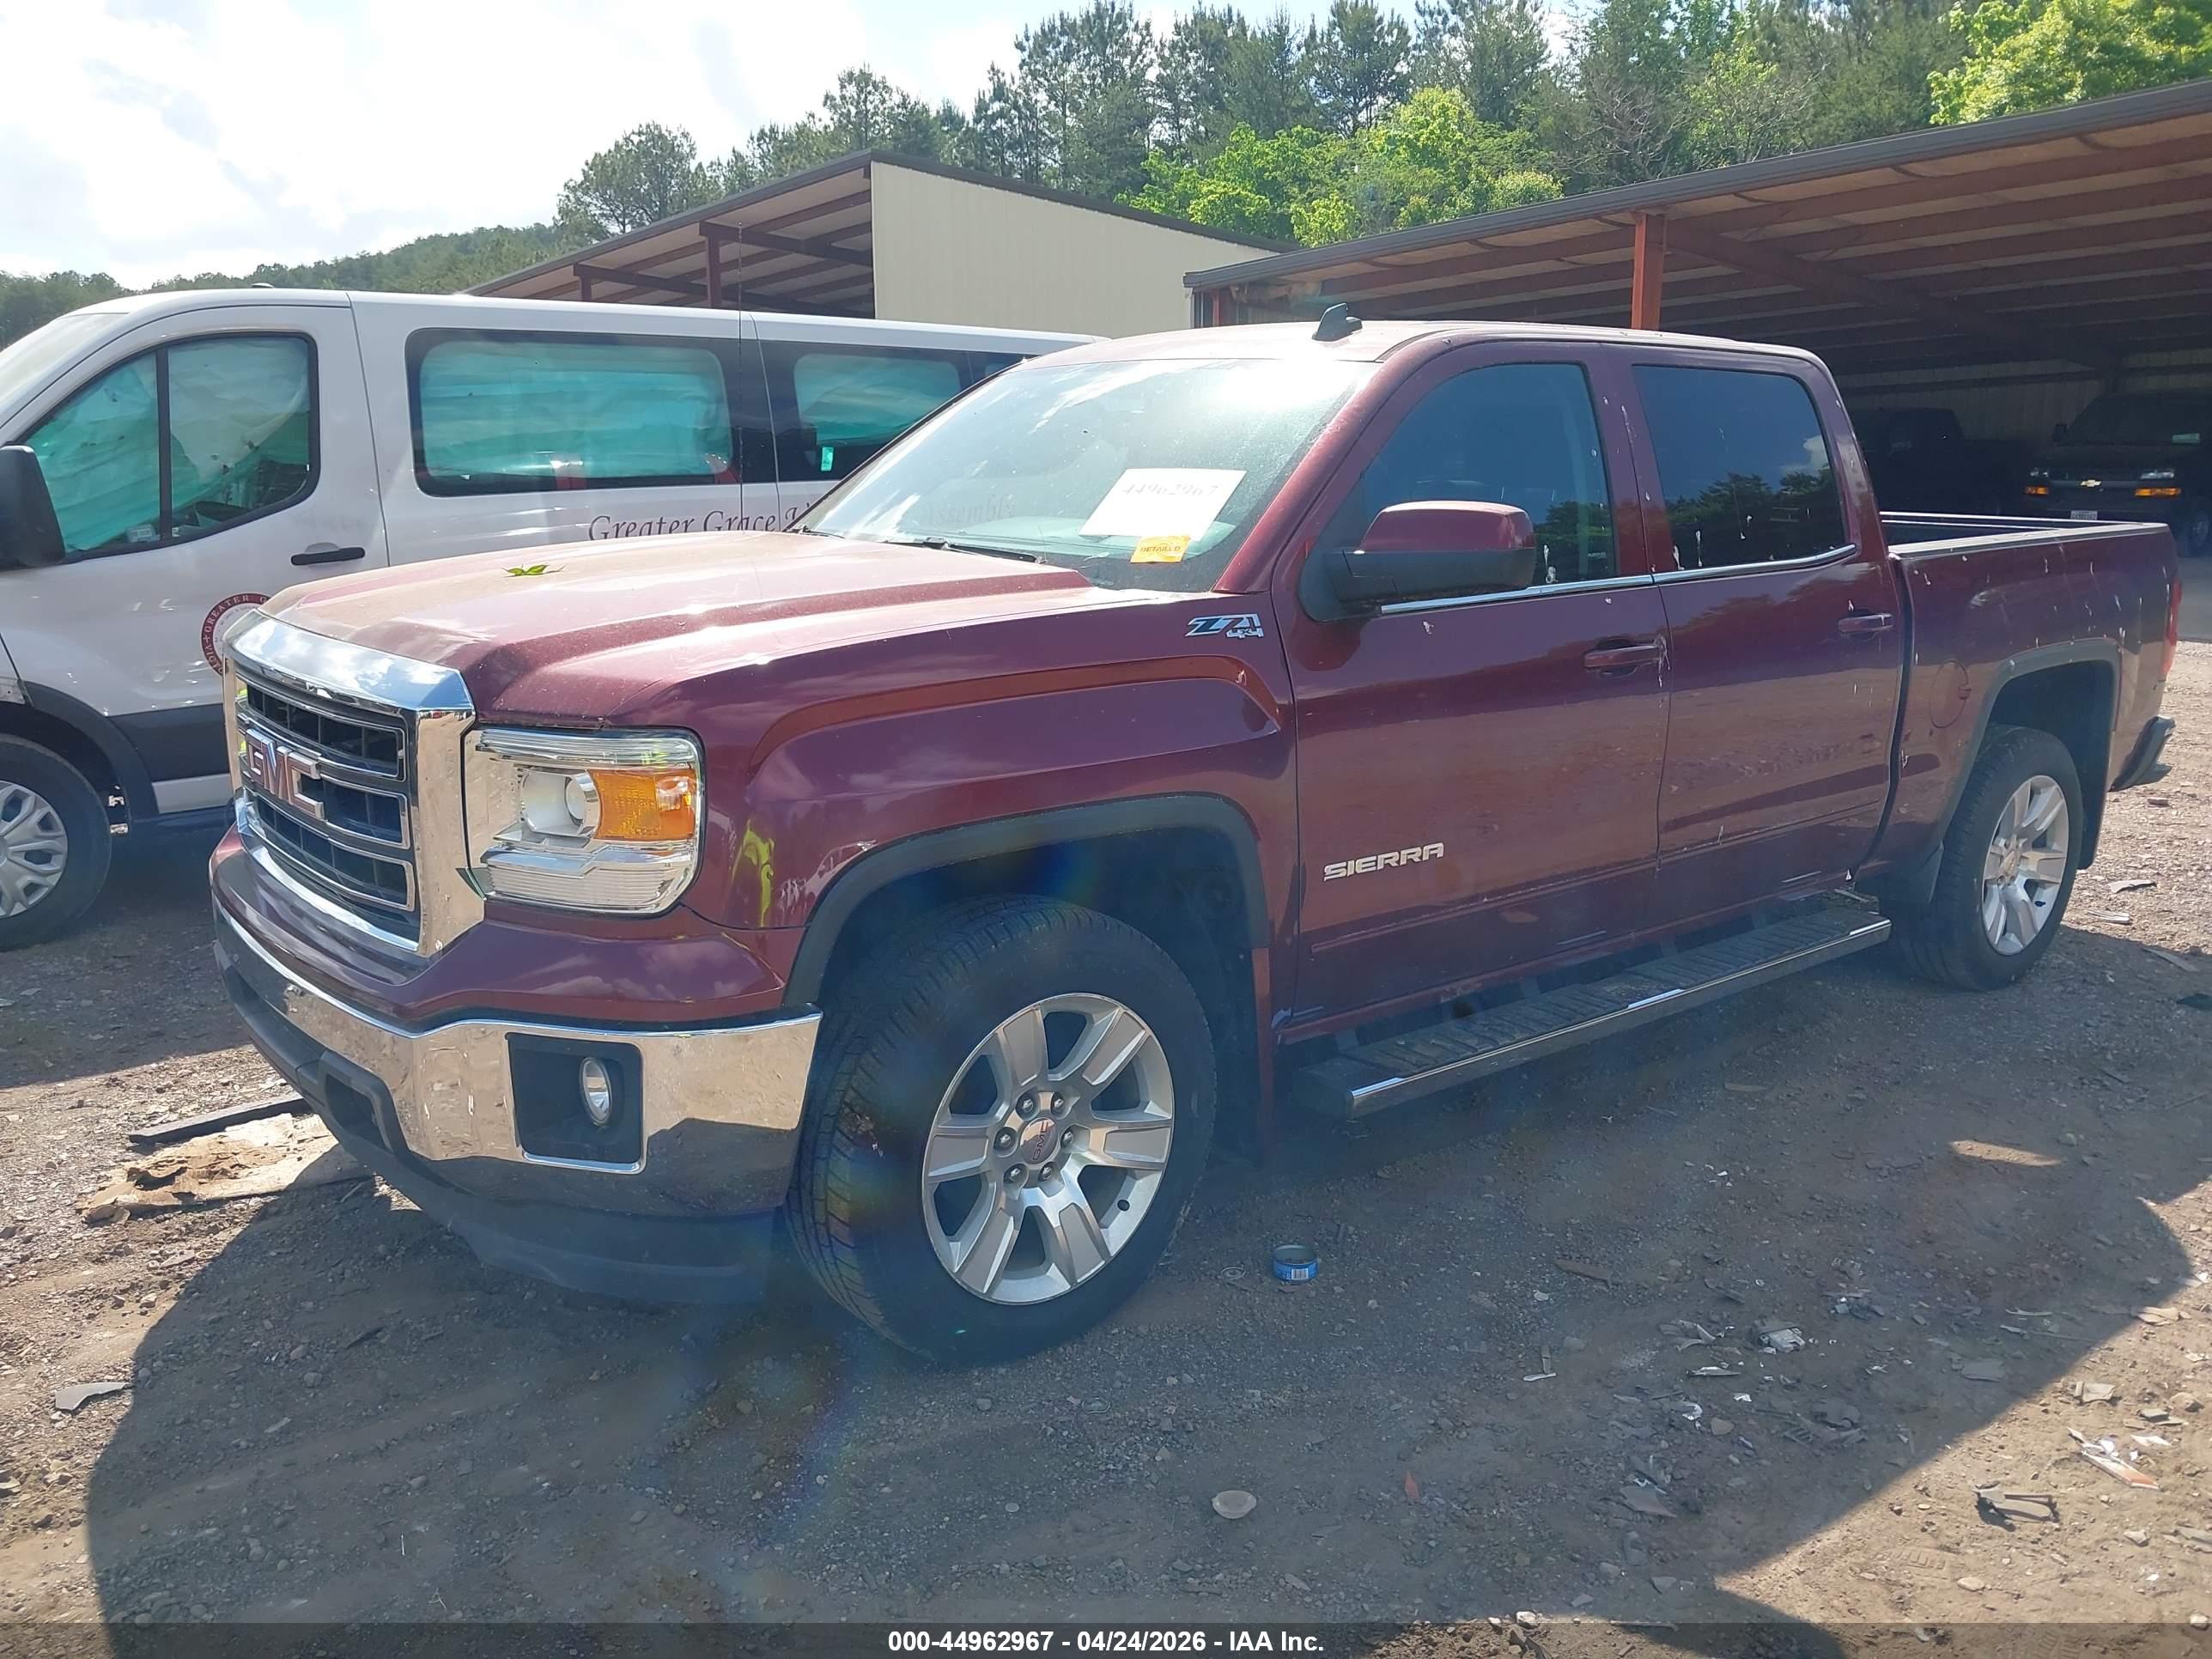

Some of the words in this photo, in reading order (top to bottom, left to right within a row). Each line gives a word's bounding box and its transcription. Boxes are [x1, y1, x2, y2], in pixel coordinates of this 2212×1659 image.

[588, 514, 695, 541] Greater
[702, 510, 776, 532] Grace
[204, 594, 250, 634] GREATER
[1185, 613, 1261, 636] Z71
[246, 728, 326, 822] GMC
[1323, 842, 1445, 882] SIERRA
[1034, 1121, 1048, 1160] GMC
